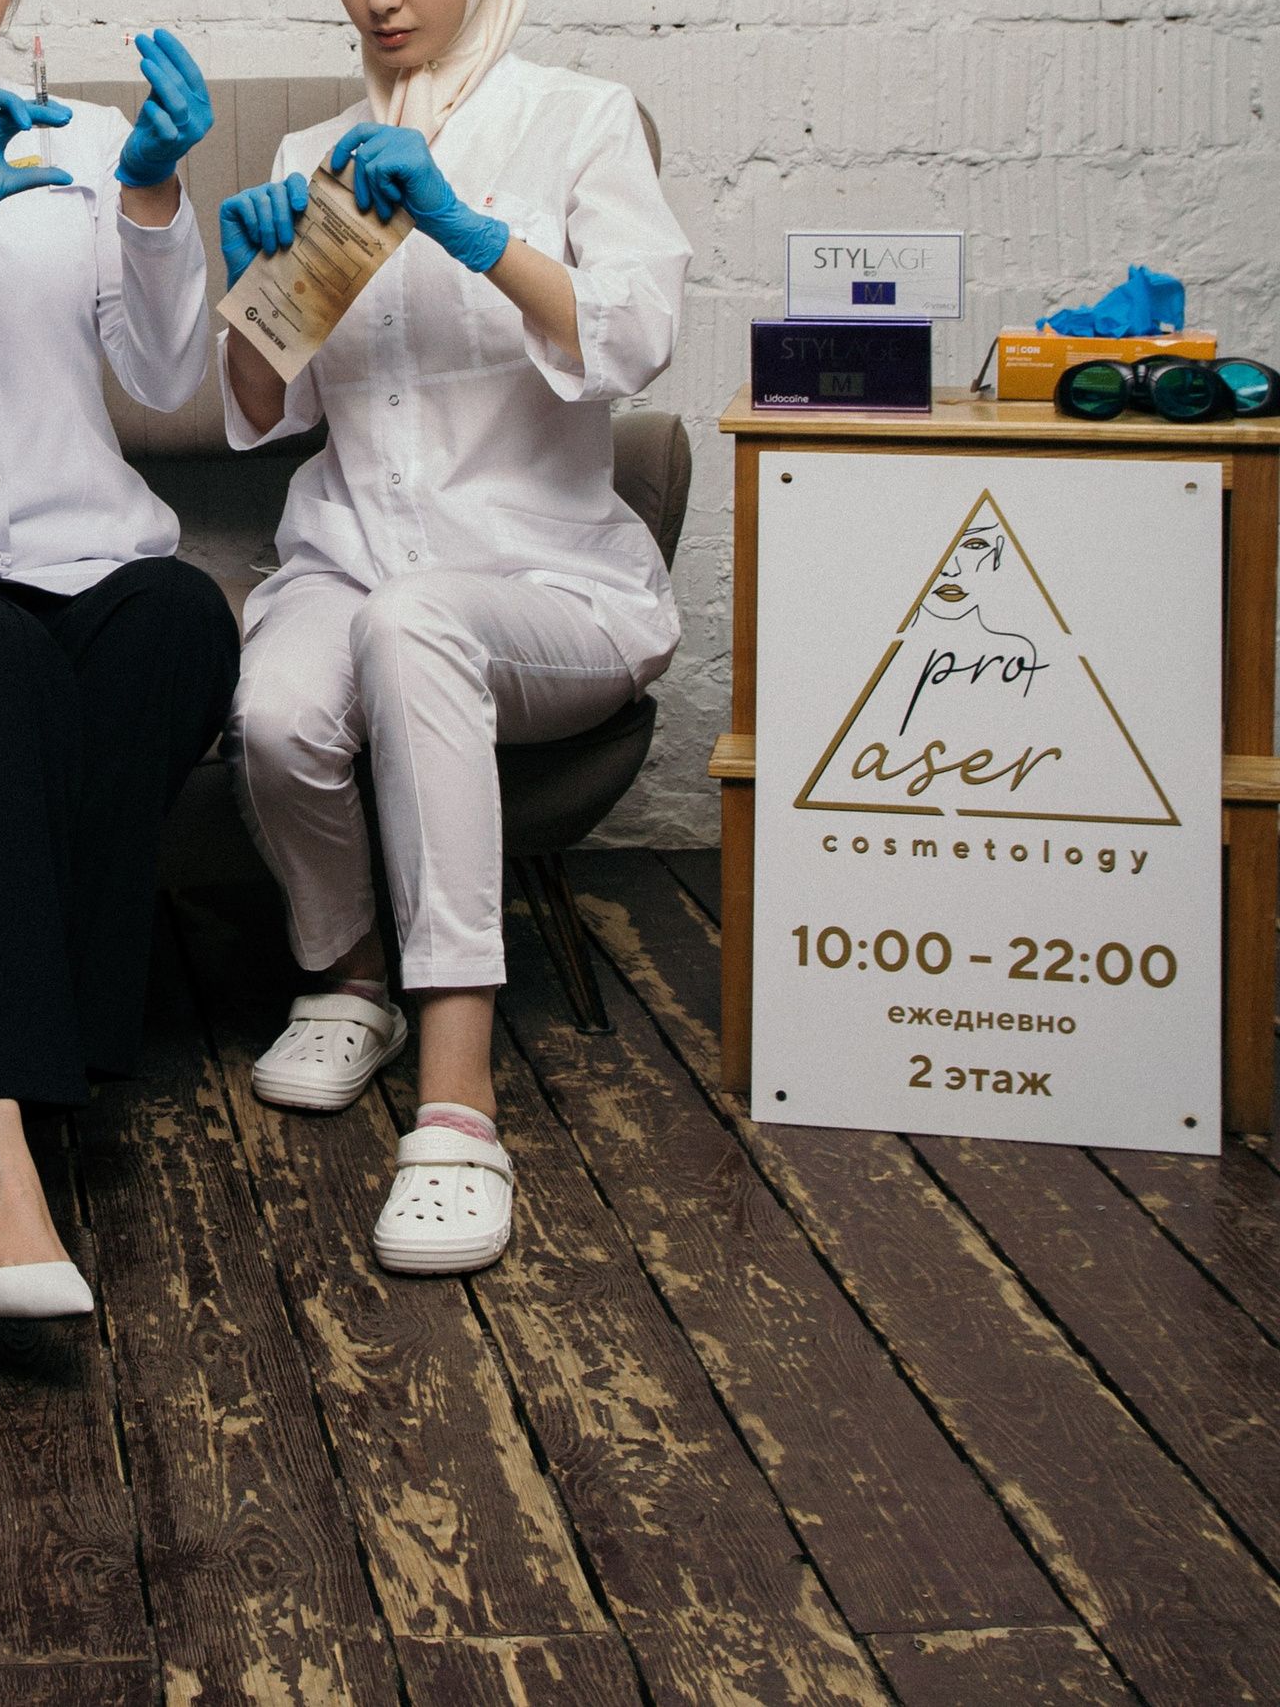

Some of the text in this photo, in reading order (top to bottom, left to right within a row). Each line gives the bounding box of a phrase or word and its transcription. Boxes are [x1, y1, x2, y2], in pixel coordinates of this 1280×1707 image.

[814, 246, 934, 270] STYLAGE
[864, 284, 883, 302] M
[832, 376, 851, 393] M
[897, 647, 1051, 737] pro
[822, 834, 1148, 875] cosmetology
[791, 925, 953, 975] 10:00
[1008, 936, 1178, 989] 22:00
[887, 1005, 1077, 1035] ежедневно
[908, 1054, 1053, 1097] 2 этаж
